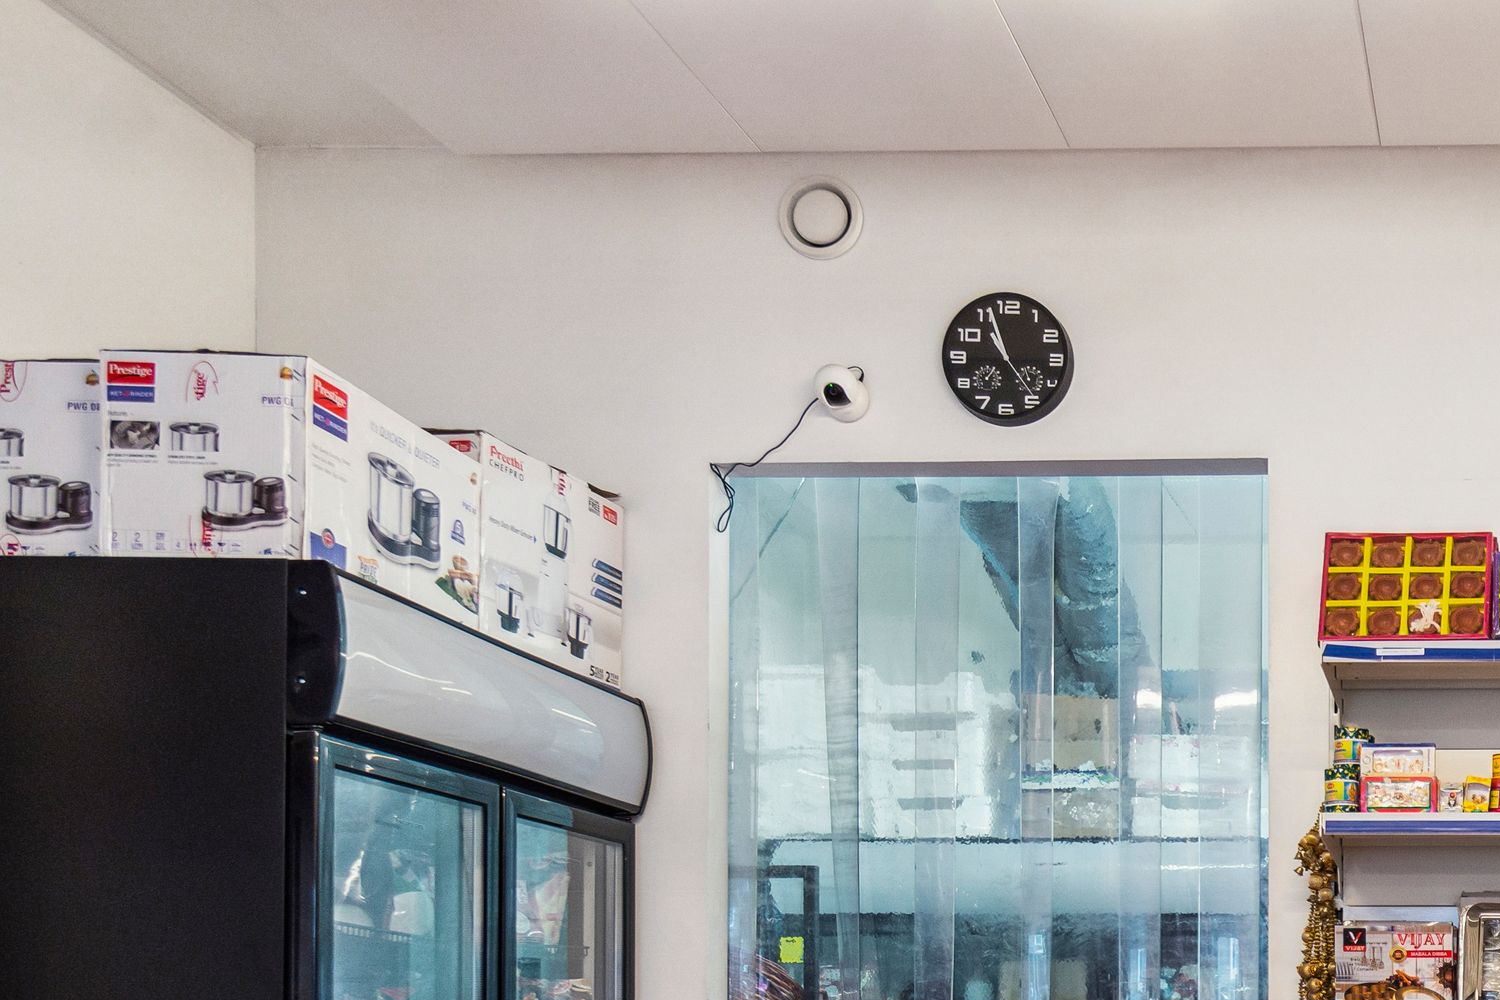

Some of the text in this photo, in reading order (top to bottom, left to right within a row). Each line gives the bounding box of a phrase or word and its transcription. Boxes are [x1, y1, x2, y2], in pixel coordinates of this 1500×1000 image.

[997, 300, 1020, 315] 12
[1032, 309, 1038, 323] 1
[958, 328, 981, 342] 10
[1043, 329, 1059, 343] 2
[950, 351, 966, 364] 9
[1050, 353, 1064, 367] 3
[109, 363, 153, 378] Prestige
[958, 378, 970, 388] 8
[315, 378, 348, 409] Prestige
[975, 396, 990, 409] 7
[1025, 395, 1040, 409] 5
[998, 404, 1014, 415] 6
[490, 445, 524, 472] Preethi
[489, 458, 525, 482] CHEFPRO
[1397, 932, 1446, 949] VIJAY
